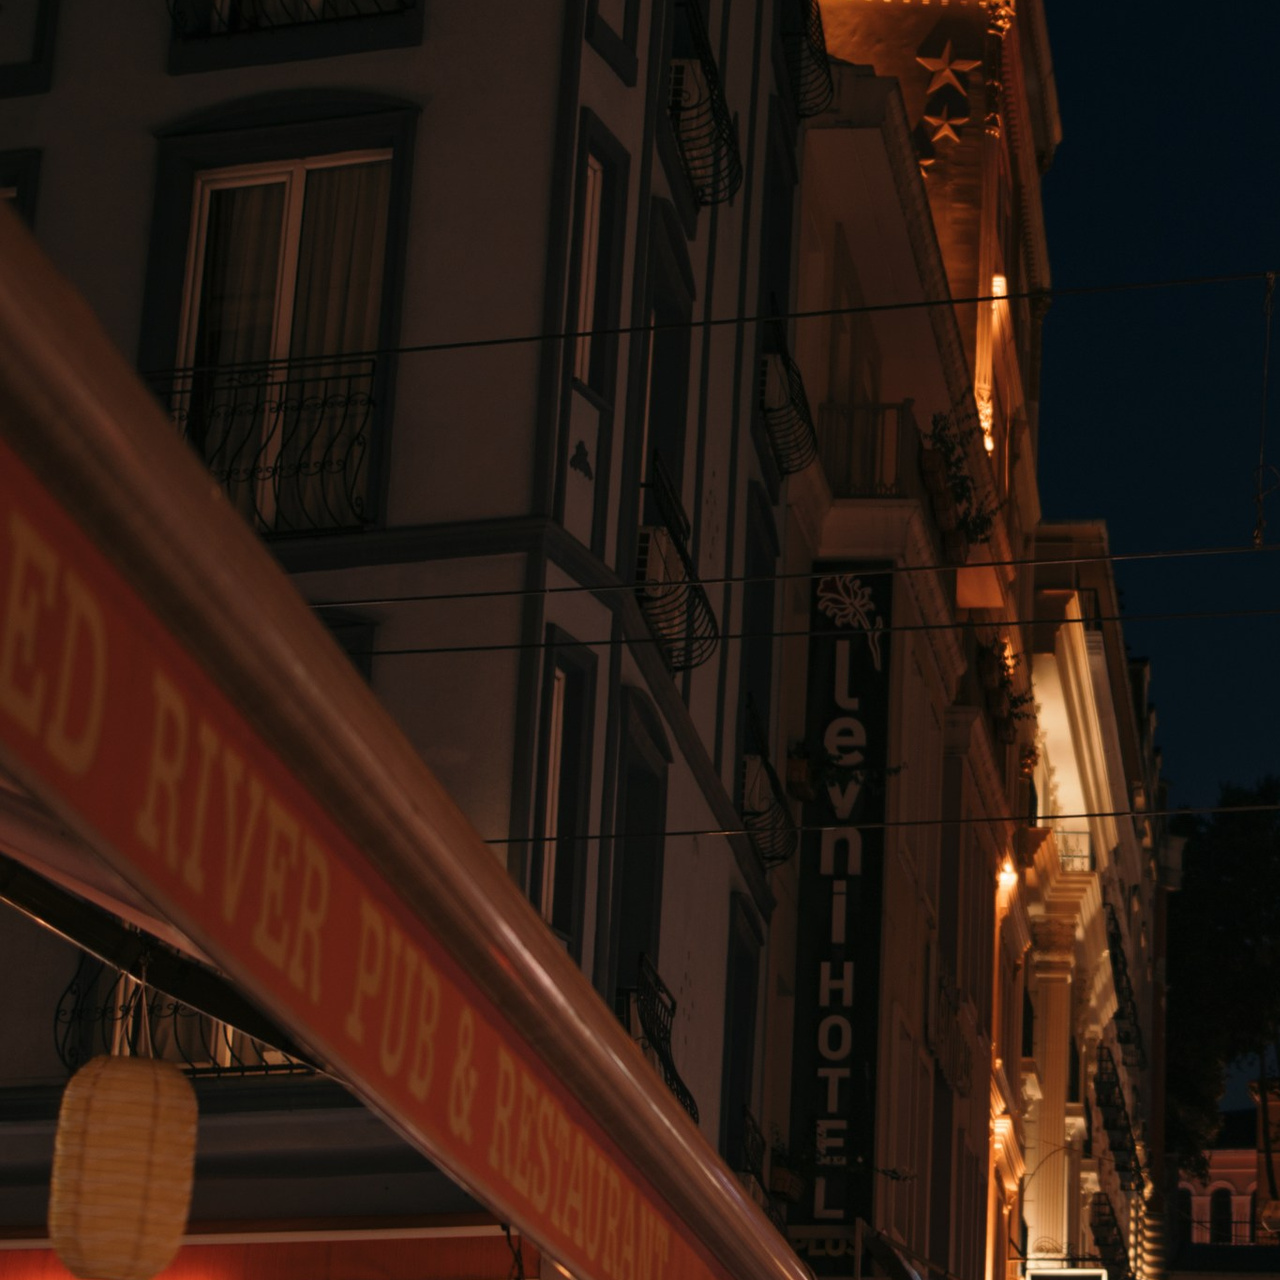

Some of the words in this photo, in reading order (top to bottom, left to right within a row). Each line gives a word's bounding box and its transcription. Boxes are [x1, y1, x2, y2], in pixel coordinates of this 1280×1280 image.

[136, 669, 329, 1005] RIVER
[346, 897, 440, 1103] PUB
[449, 1005, 478, 1144] &
[813, 961, 853, 1220] HOTEL
